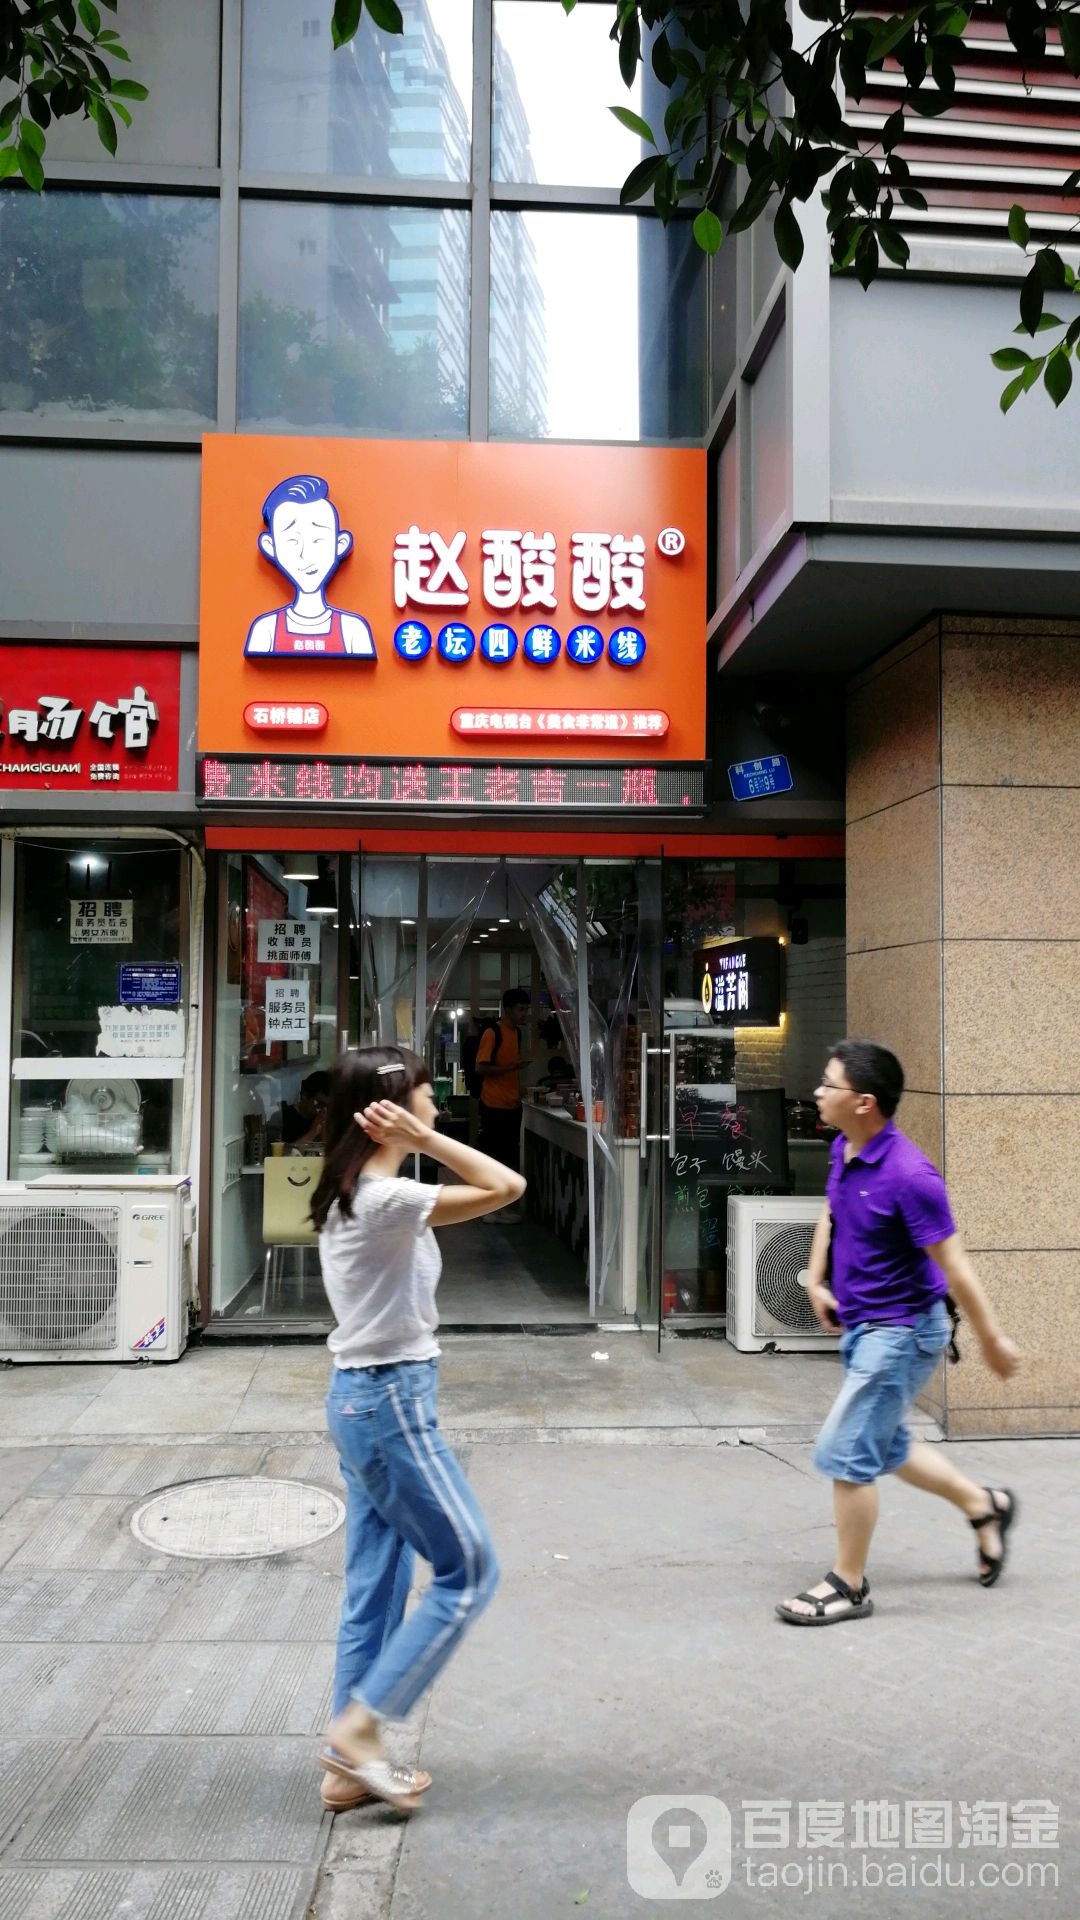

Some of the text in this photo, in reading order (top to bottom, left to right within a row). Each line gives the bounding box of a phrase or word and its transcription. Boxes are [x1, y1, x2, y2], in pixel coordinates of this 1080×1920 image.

[393, 525, 647, 612] 赵酸酸
[401, 624, 639, 661] 老坛四鲜米线
[0, 685, 160, 749] 肠馆
[253, 706, 320, 725] 石桥铺店
[459, 712, 663, 731] 重庆电视台《美食非常道》推荐
[78, 901, 123, 918] 招聘
[274, 923, 306, 936] 招聘
[267, 936, 312, 948] 收银员
[267, 950, 312, 962] 挑面师傅
[275, 988, 300, 998] 招聘
[268, 1001, 306, 1014] 服务员
[268, 1017, 307, 1029] 钟点工
[671, 1148, 773, 1176] 包子 馒头
[141, 1213, 166, 1221] GREE
